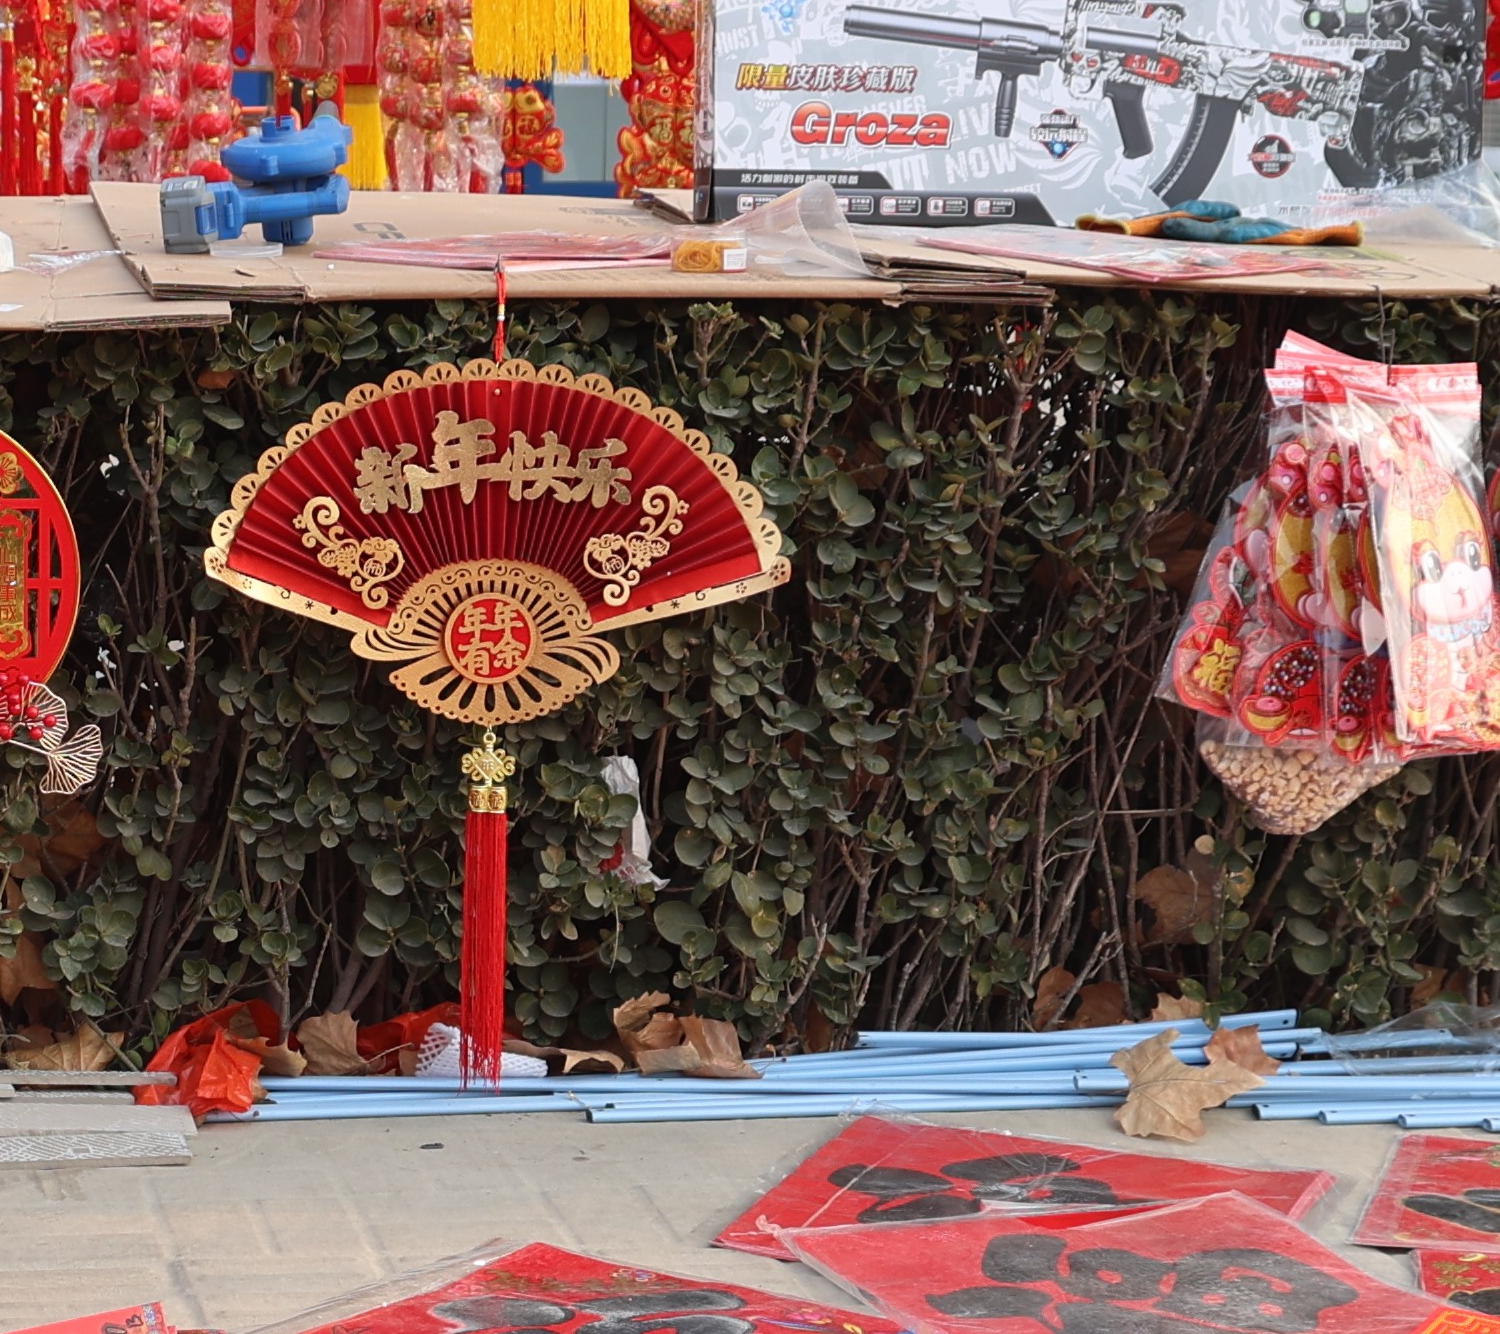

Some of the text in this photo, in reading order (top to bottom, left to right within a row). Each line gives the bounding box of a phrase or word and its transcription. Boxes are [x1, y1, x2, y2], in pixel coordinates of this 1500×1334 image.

[736, 63, 918, 94] 限量皮肤珍藏版
[789, 99, 955, 150] Groza
[352, 409, 634, 515] 新年快乐
